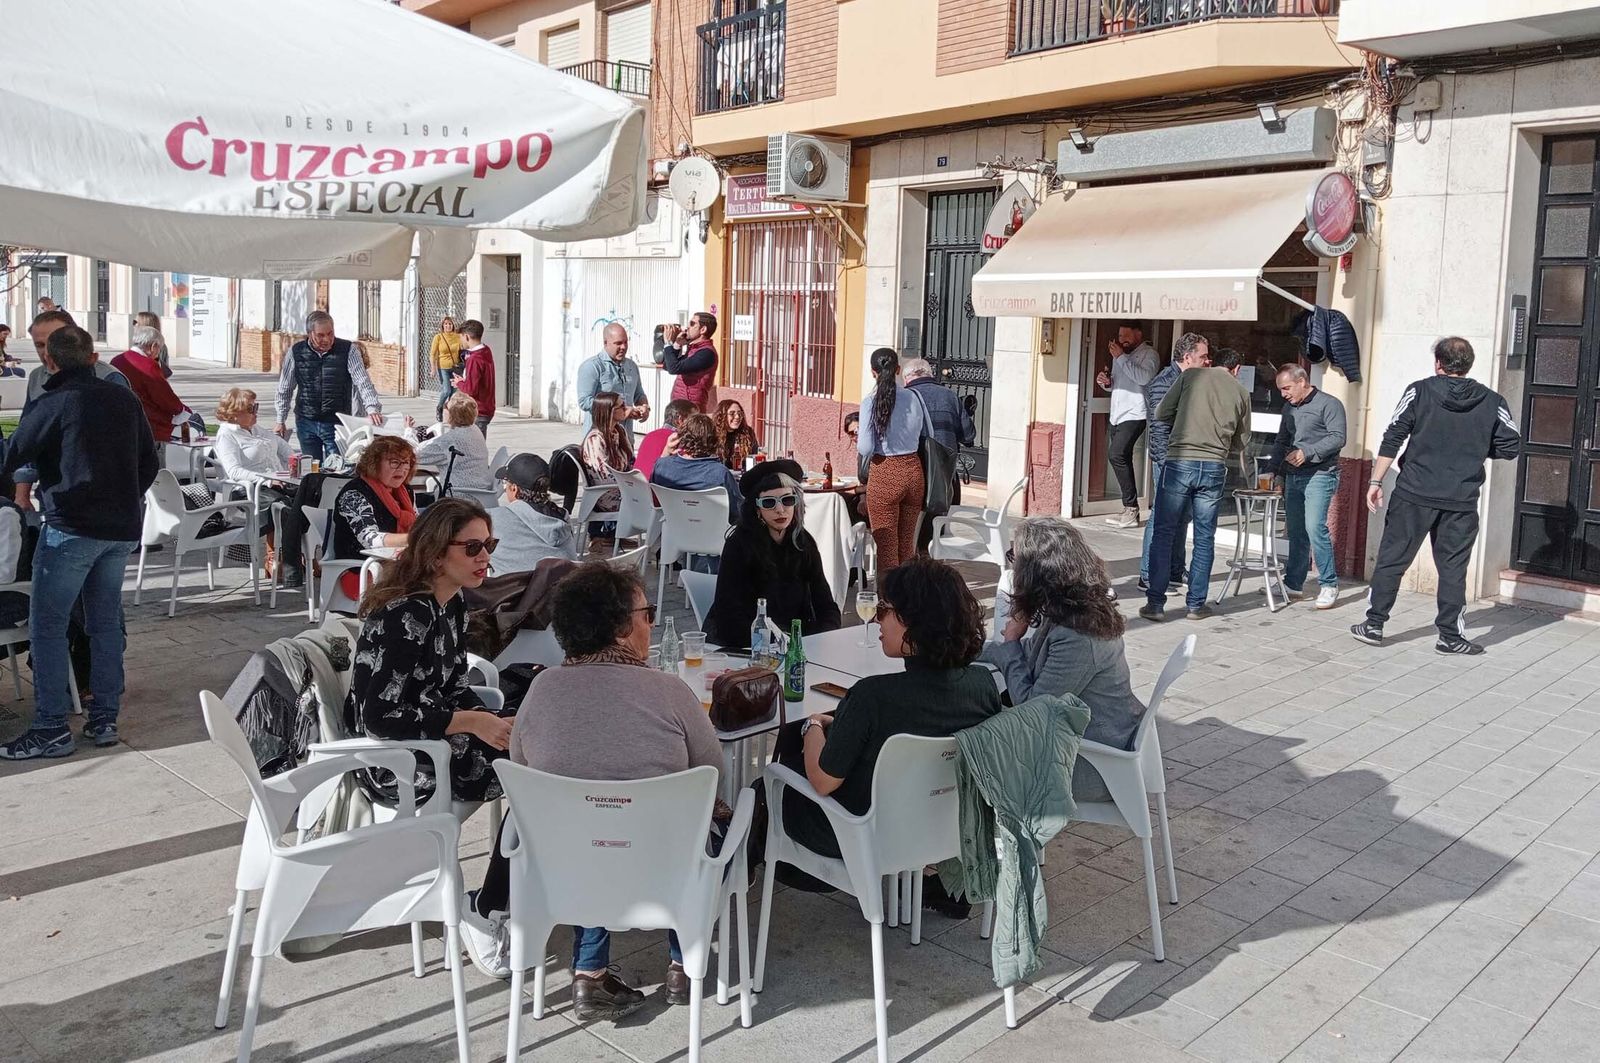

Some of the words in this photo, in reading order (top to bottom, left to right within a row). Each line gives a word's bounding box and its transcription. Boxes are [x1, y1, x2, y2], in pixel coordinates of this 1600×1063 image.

[285, 115, 373, 134] DESDE
[402, 122, 469, 138] 1904
[164, 115, 553, 182] Cruzcampo
[252, 180, 475, 218] ESPECIAL
[732, 186, 768, 200] TERTU
[984, 233, 1012, 249] Cruz
[1050, 293, 1074, 313] BAR
[1080, 292, 1143, 314] TERTULIA
[1159, 294, 1239, 315] Cruzcampo
[585, 795, 632, 804] Cruzcampo
